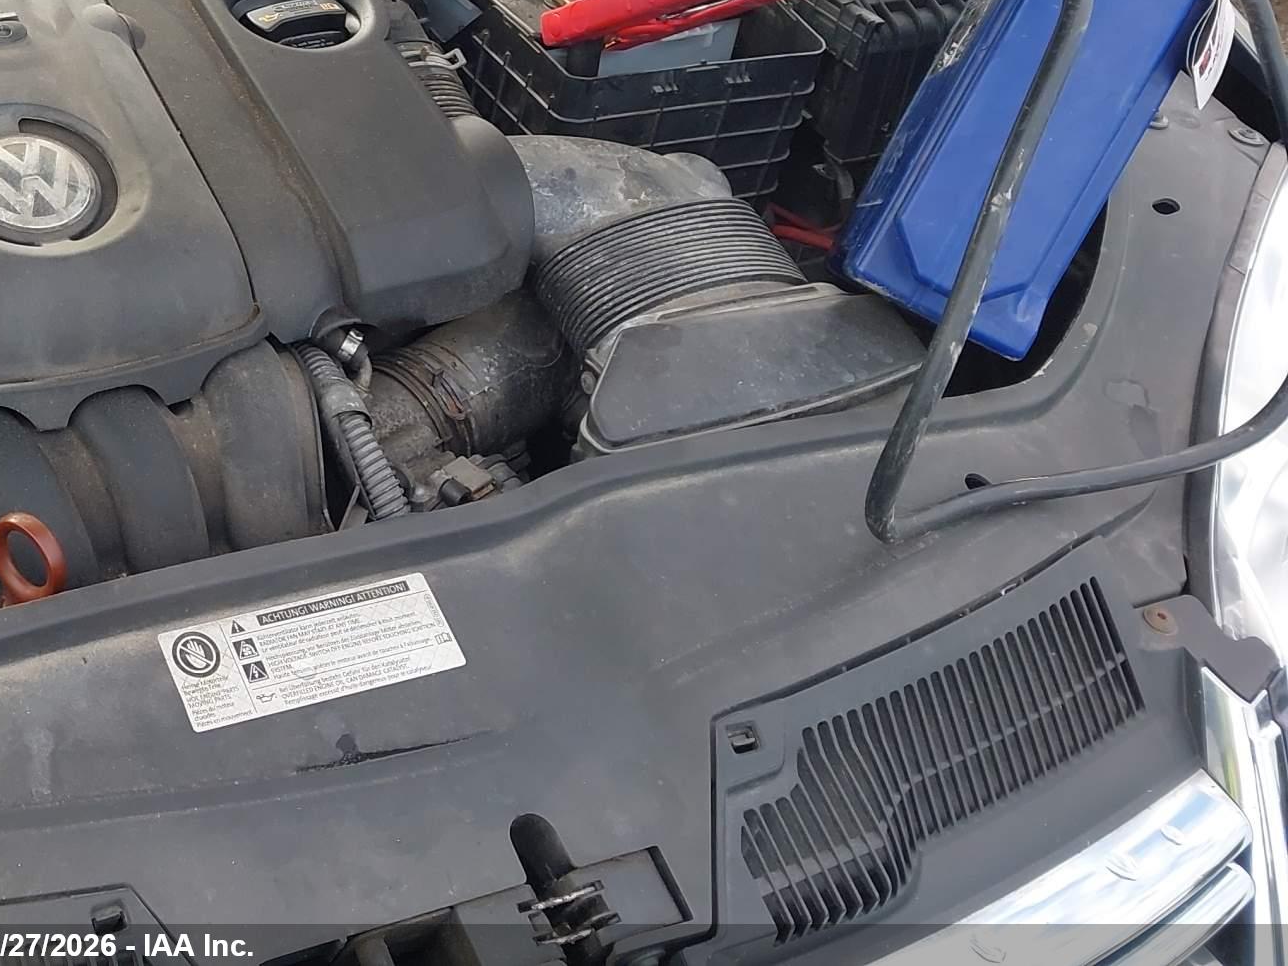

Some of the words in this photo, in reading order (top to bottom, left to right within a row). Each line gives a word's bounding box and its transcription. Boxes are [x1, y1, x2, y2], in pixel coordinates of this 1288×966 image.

[262, 606, 308, 623] ACHTUNG!
[308, 594, 355, 611] WARNING!
[356, 583, 406, 600] ATTENTION!
